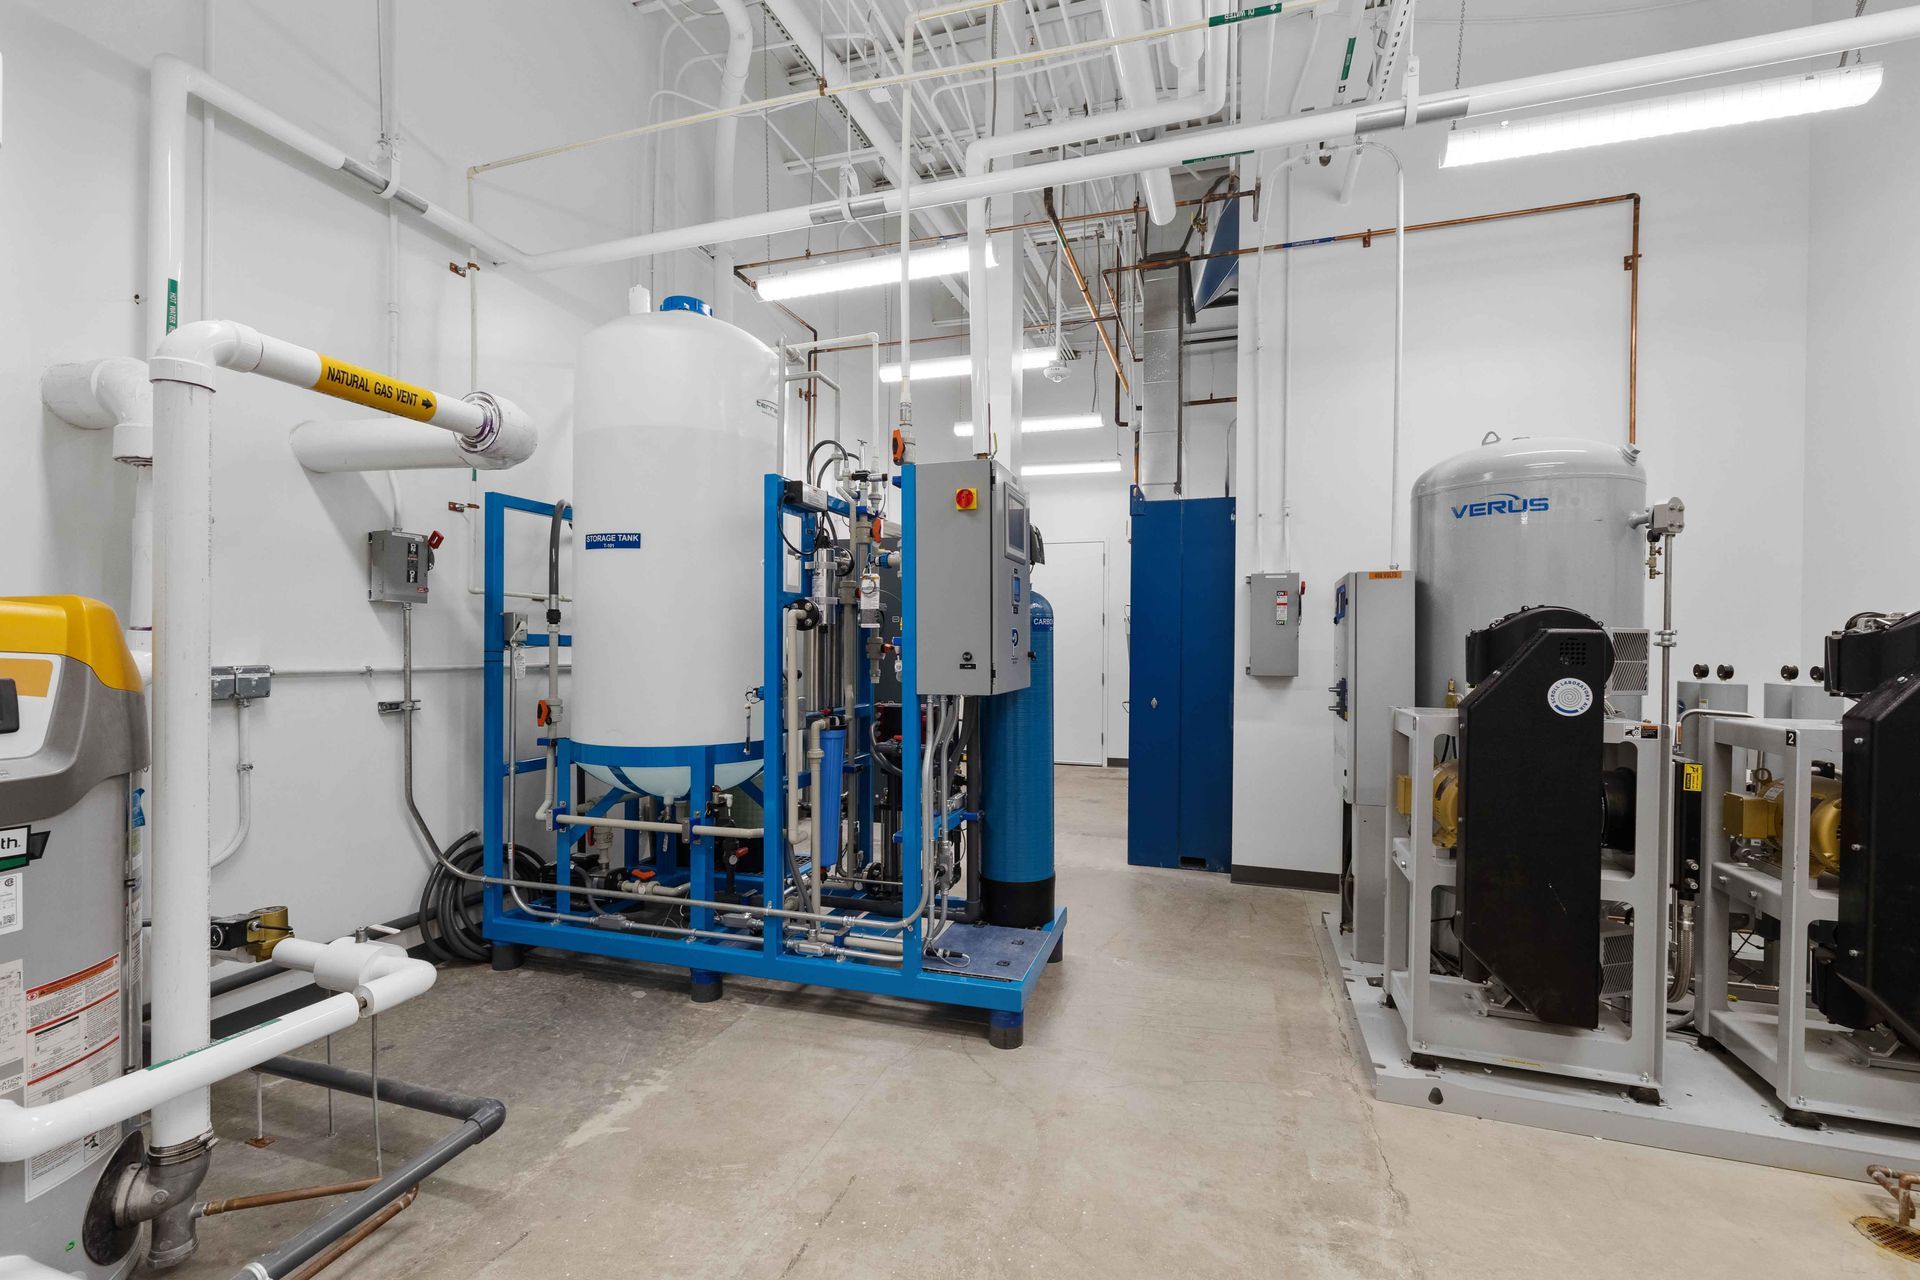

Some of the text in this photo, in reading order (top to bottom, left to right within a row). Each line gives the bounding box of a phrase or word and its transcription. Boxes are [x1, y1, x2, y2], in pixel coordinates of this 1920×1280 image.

[326, 366, 419, 407] NATURAL GAS VENT
[1451, 498, 1550, 519] VERUS
[586, 534, 640, 543] STORAGE TANK
[1788, 732, 1794, 744] 2
